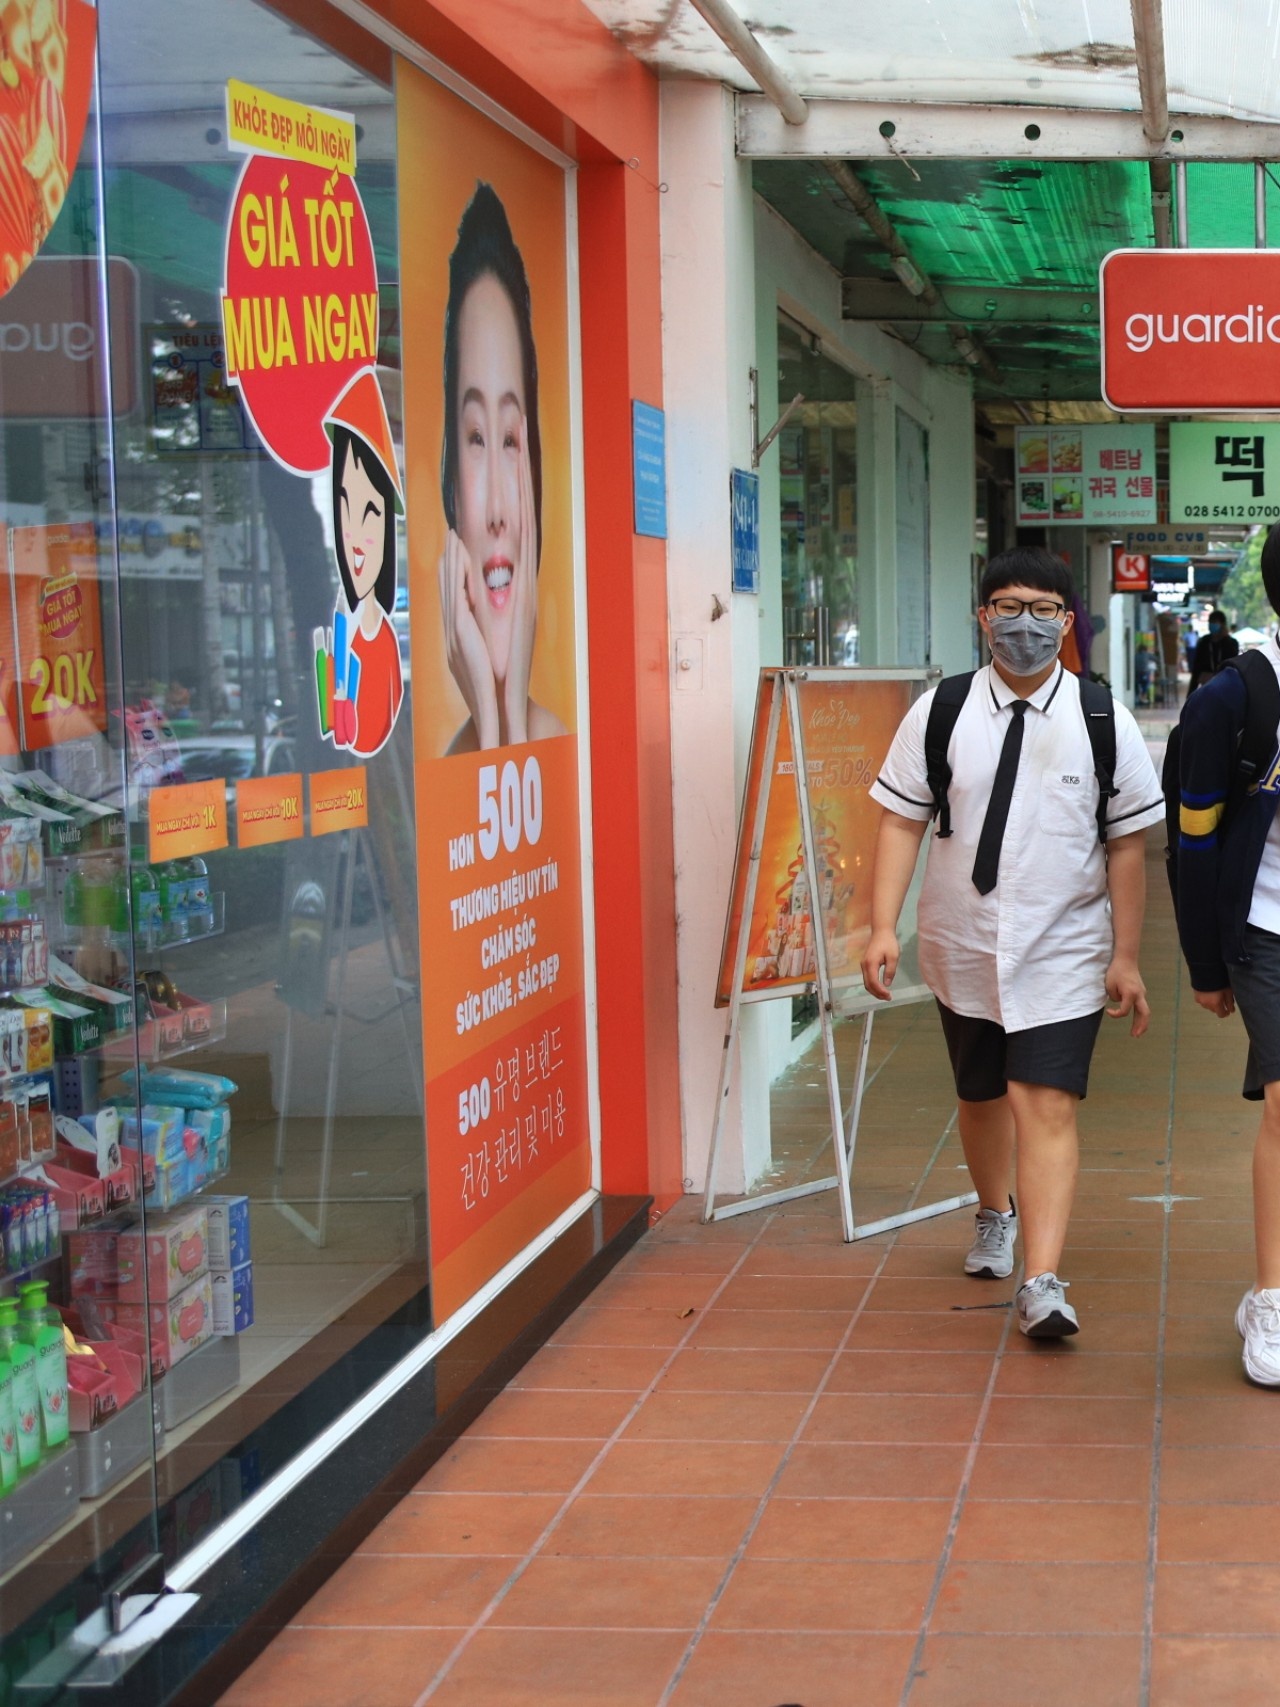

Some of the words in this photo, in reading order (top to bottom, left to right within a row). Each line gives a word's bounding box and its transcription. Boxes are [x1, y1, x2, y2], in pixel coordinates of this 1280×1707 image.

[234, 96, 268, 137] KHỎE
[271, 112, 292, 151] ĐẸP
[296, 112, 319, 153] MỖI
[321, 128, 350, 163] NGÀY
[240, 174, 300, 268] GIÁ
[304, 164, 354, 268] TỐT
[223, 296, 298, 372] MUA
[303, 293, 378, 364] NGAY
[1088, 477, 1117, 498] 귀국
[1125, 476, 1154, 498] 선물
[1099, 449, 1143, 471] 베트남
[1215, 436, 1265, 497] 떡
[1127, 532, 1168, 548] FOOD
[1175, 532, 1205, 542] CVS
[1184, 505, 1208, 518] 028
[1212, 505, 1244, 518] 5412
[29, 650, 97, 715] 20K
[203, 804, 217, 829] 1K
[281, 796, 299, 820] 10K
[347, 787, 364, 810] 20K
[448, 833, 475, 872] HƠN
[479, 755, 543, 861] 500
[450, 884, 499, 932] THƯƠNG
[500, 870, 526, 916] HIỆU
[527, 865, 542, 900] UY
[541, 857, 559, 893] TÍN
[481, 924, 514, 970] CHĂM
[515, 913, 536, 953] SÓC
[456, 991, 481, 1035] SỨC
[518, 953, 539, 1000] SẮC
[540, 953, 560, 993] ĐẸP
[458, 1076, 491, 1136] 500
[494, 1047, 521, 1112] 유명
[525, 1026, 564, 1089] 브랜드
[460, 1141, 491, 1211] 건강
[494, 1117, 522, 1183] 관리
[525, 1105, 539, 1164] 및
[541, 1087, 566, 1145] 미용
